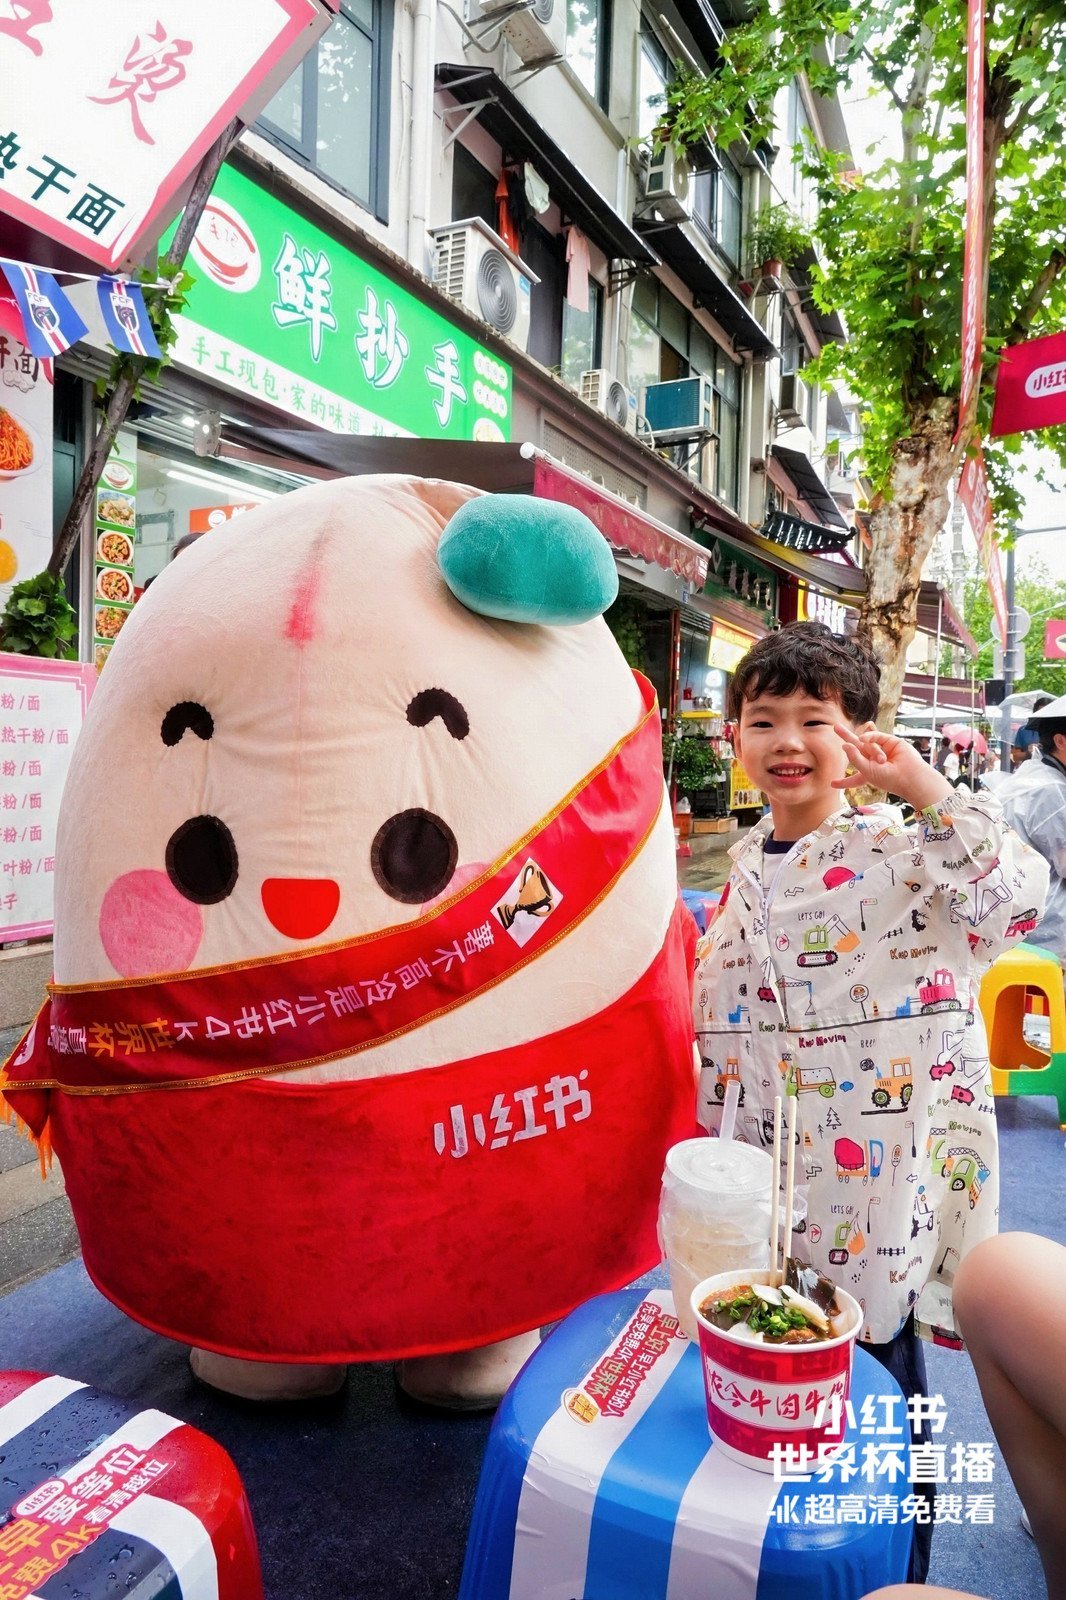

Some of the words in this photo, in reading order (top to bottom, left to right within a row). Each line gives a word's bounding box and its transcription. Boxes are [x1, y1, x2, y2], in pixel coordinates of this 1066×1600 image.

[112, 294, 131, 304] FCF
[272, 234, 466, 427] 鲜抄手
[0, 893, 17, 911] 子
[434, 1069, 592, 1159] 小红书
[24, 1483, 60, 1511] 小红书
